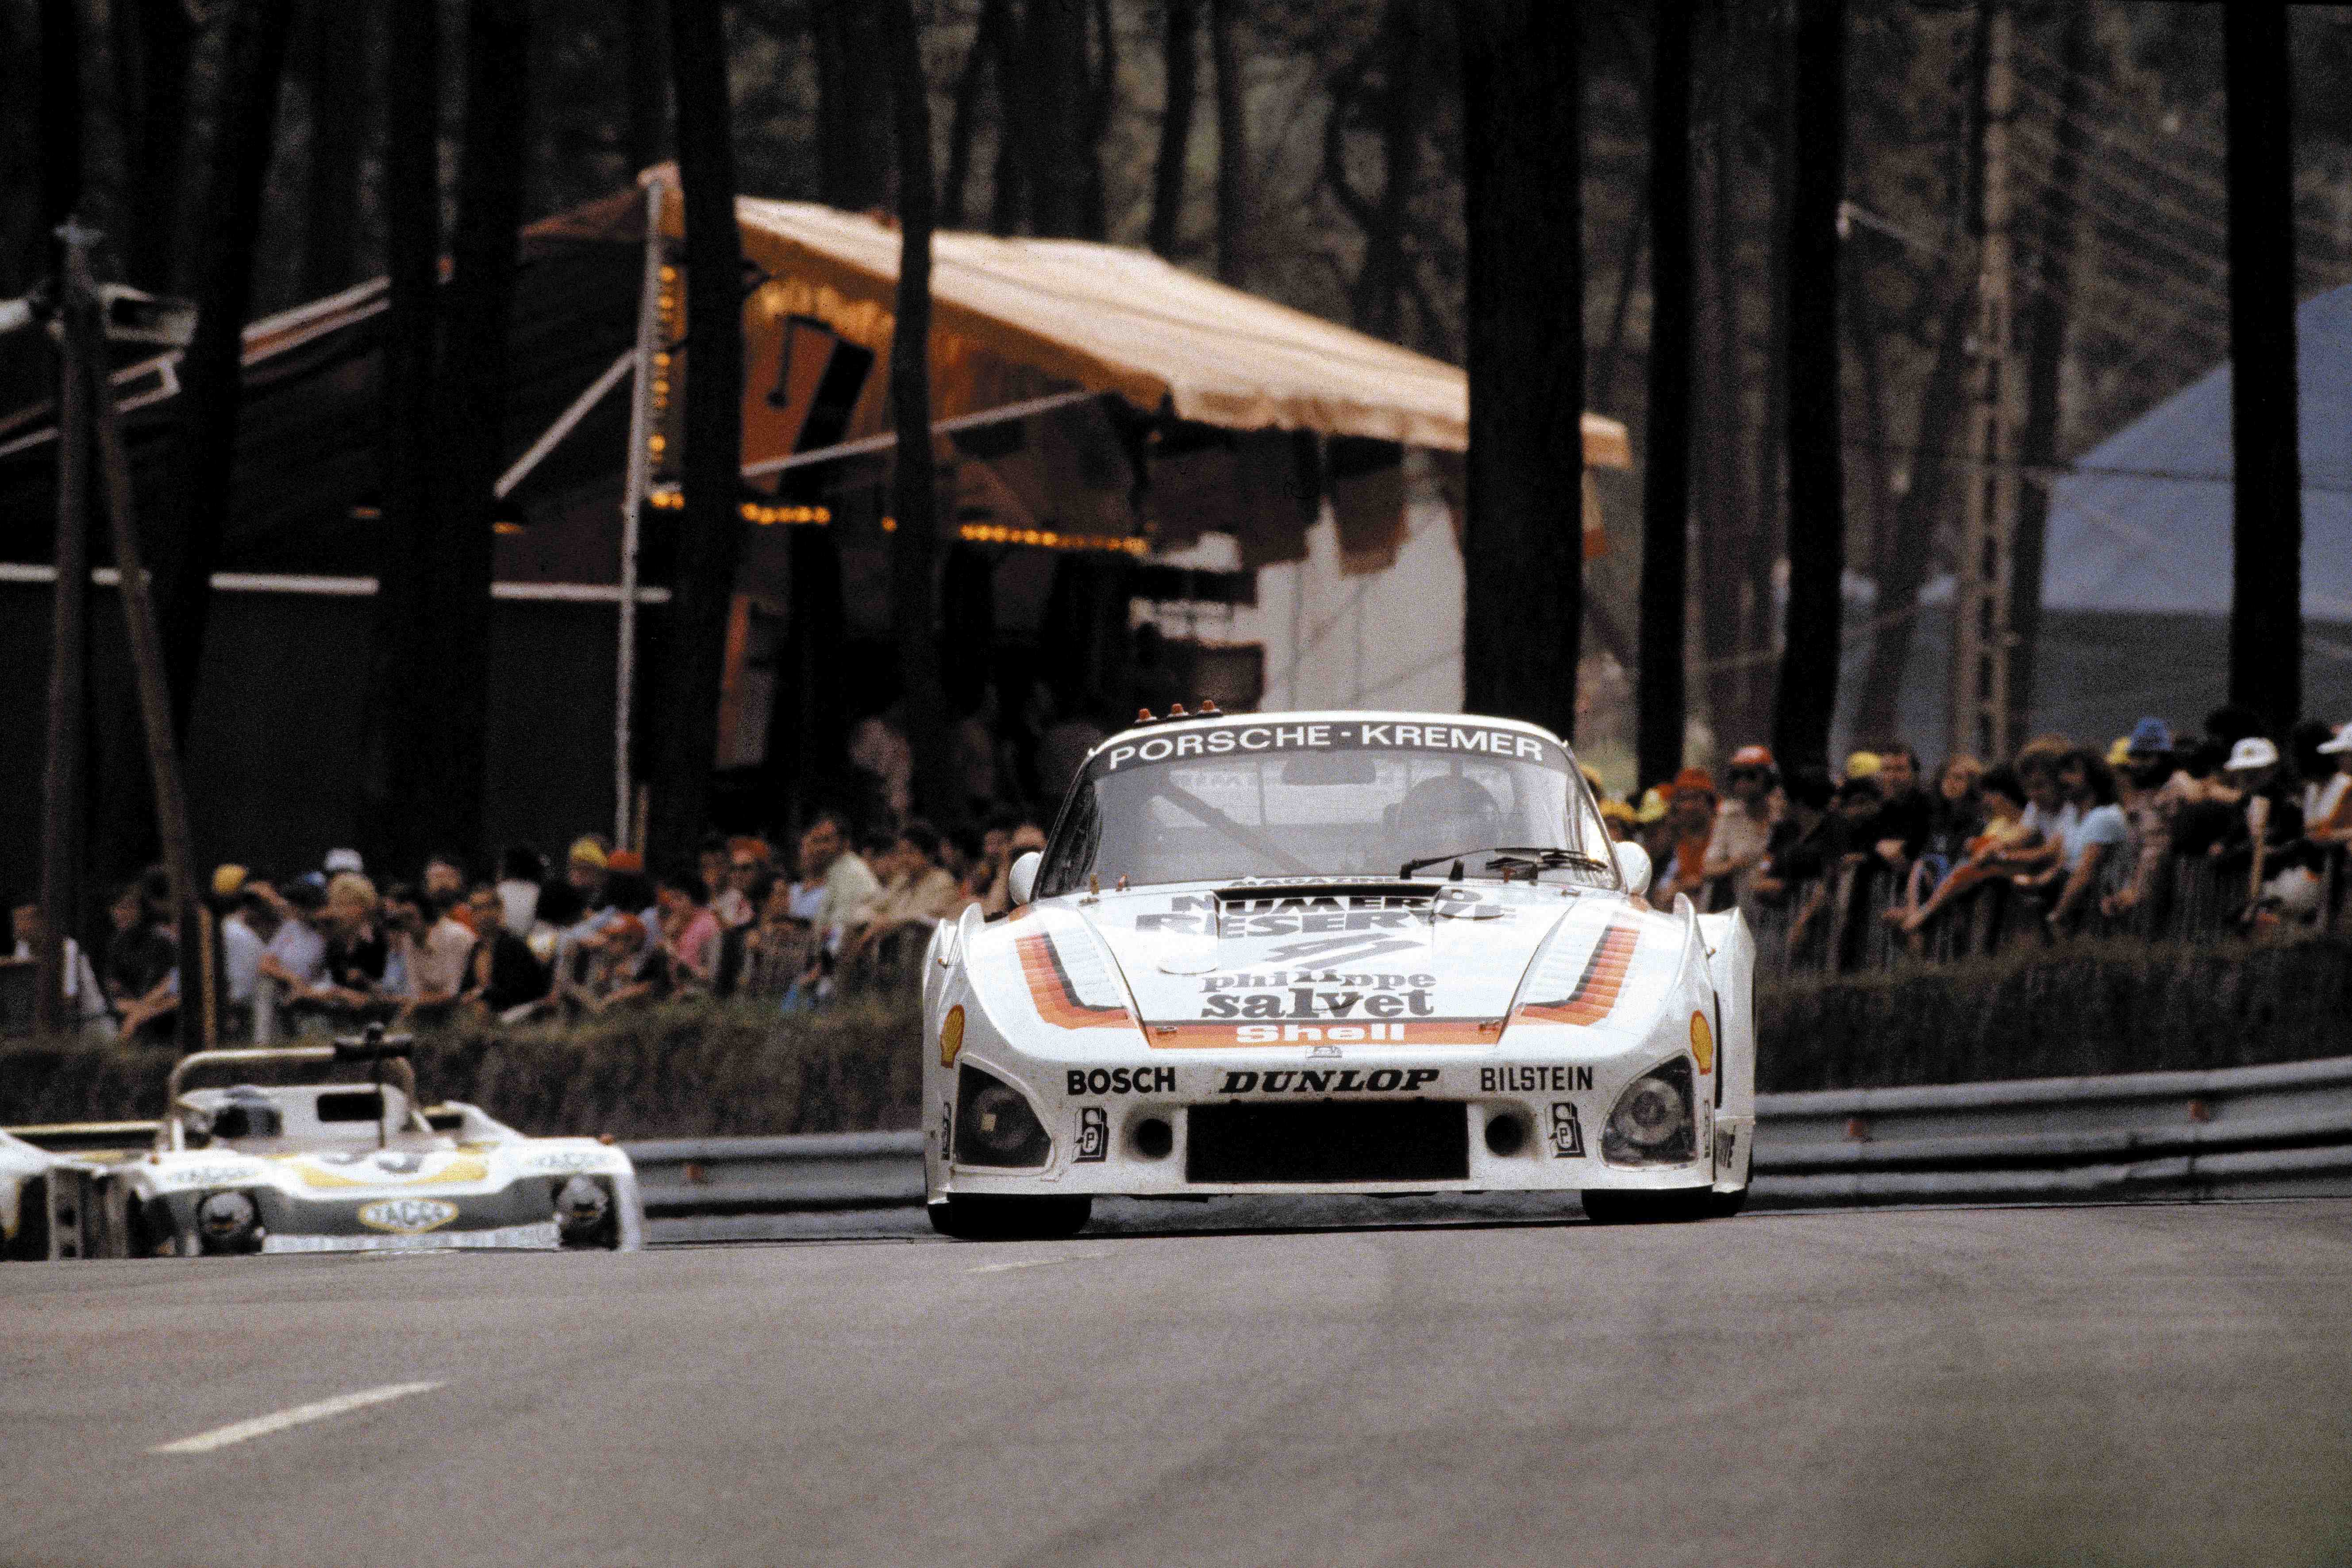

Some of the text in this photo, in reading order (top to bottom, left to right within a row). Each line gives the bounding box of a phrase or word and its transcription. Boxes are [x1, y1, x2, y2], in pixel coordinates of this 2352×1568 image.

[1171, 890, 1483, 914] NUMERO
[1201, 970, 1436, 992] philippe
[1201, 988, 1435, 1018] salvet
[1237, 1024, 1405, 1043] Shell
[1067, 1067, 1175, 1096] BOSCH
[1220, 1070, 1440, 1093] DUNLOP
[1481, 1067, 1594, 1091] BILSTEIN
